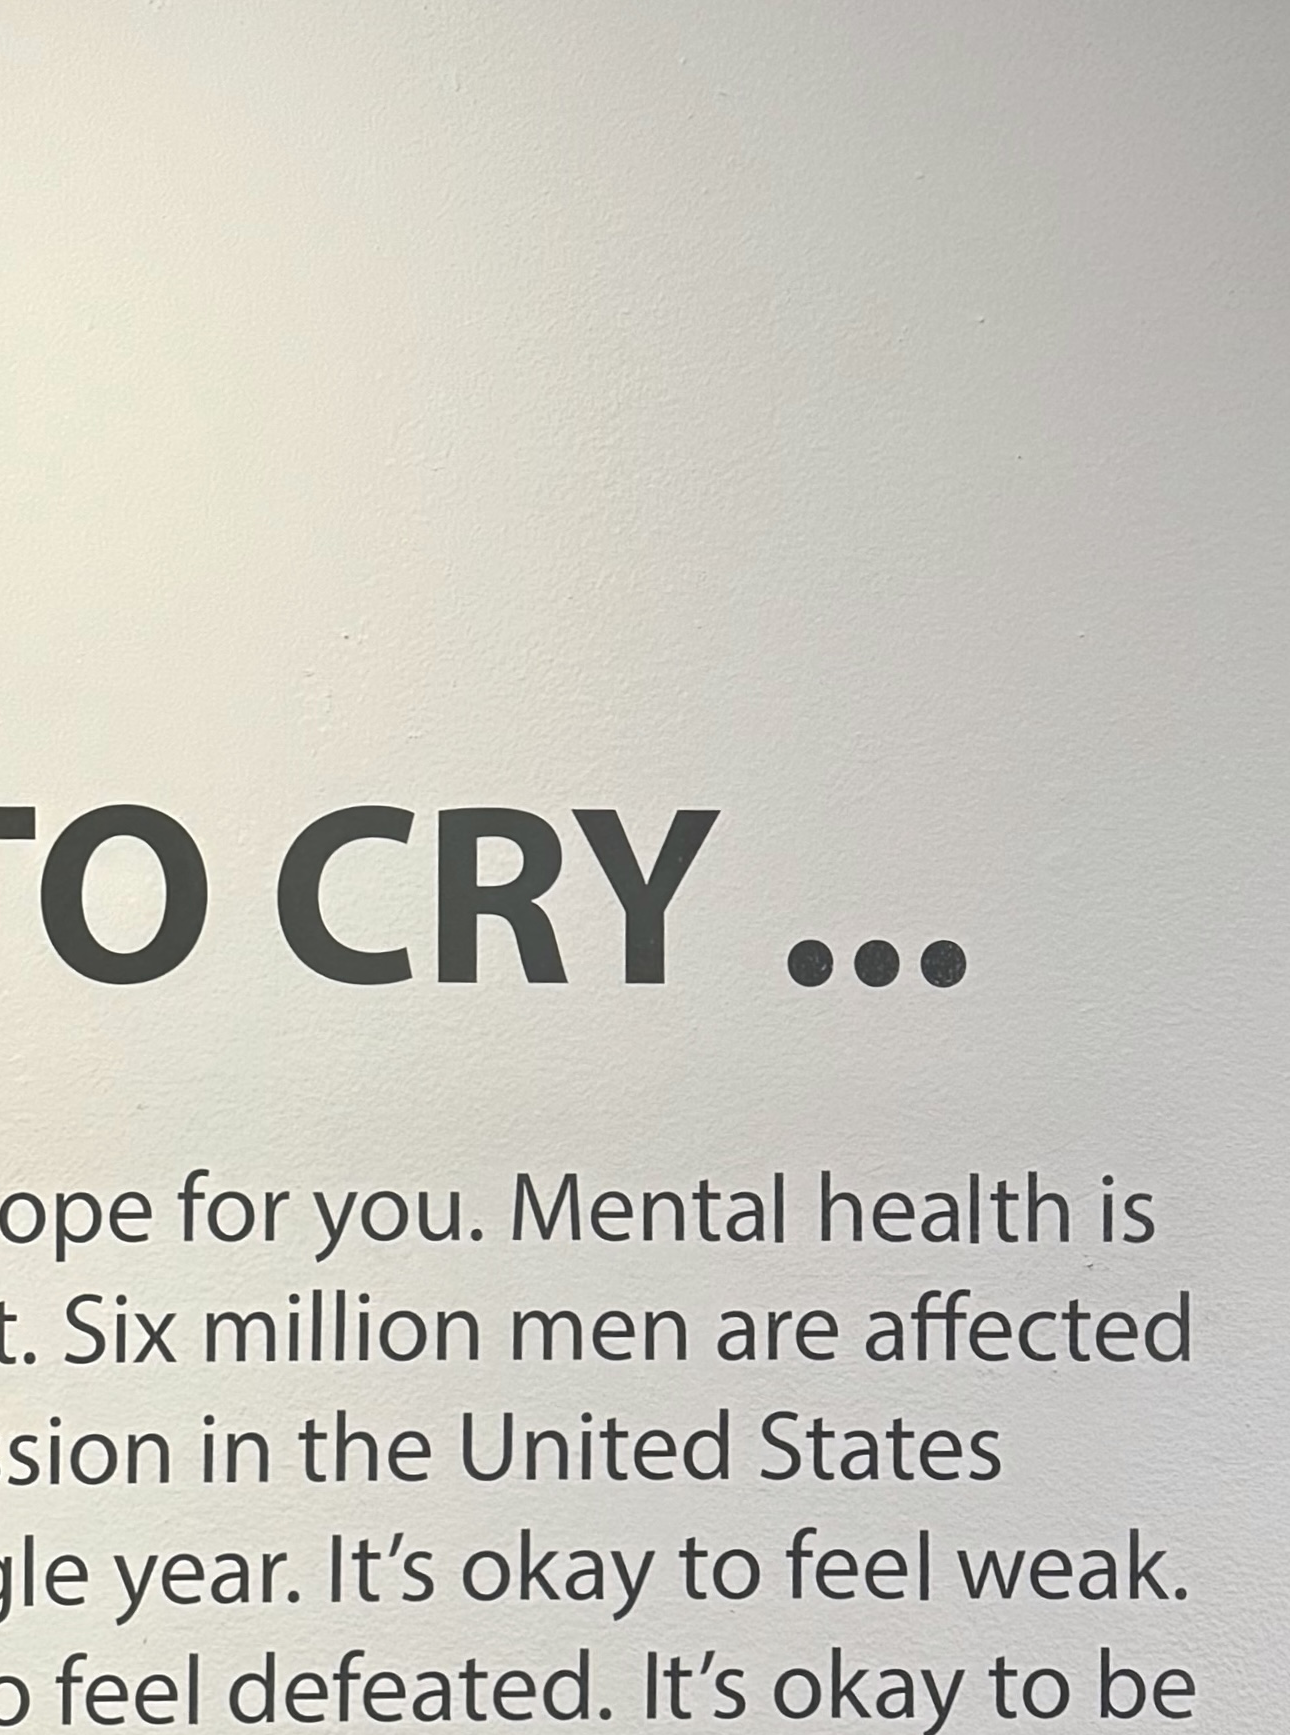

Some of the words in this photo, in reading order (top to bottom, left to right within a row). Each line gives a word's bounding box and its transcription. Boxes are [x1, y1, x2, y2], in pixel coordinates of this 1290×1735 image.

[275, 803, 723, 987] CRY
[175, 1167, 292, 1244] for
[311, 1189, 485, 1265] you.
[510, 1170, 786, 1245] Mental
[819, 1168, 1071, 1246] health
[1100, 1173, 1157, 1245] is
[62, 1292, 179, 1366] Six
[204, 1287, 481, 1364] million
[511, 1308, 688, 1363] men
[715, 1308, 840, 1363] are
[864, 1287, 1192, 1364] affected
[202, 1412, 271, 1485] in
[296, 1408, 433, 1484] the
[461, 1406, 731, 1483] United
[758, 1409, 1003, 1483] States
[111, 1550, 302, 1628] year.
[329, 1530, 436, 1604] It’s
[461, 1526, 657, 1623] okay
[677, 1535, 762, 1602] to
[783, 1525, 931, 1603] feel
[955, 1526, 1189, 1602] weak.
[53, 1650, 200, 1727] feel
[227, 1646, 614, 1726] defeated.
[645, 1648, 748, 1721] It’s
[986, 1654, 1072, 1721] to
[1098, 1645, 1197, 1721] be
